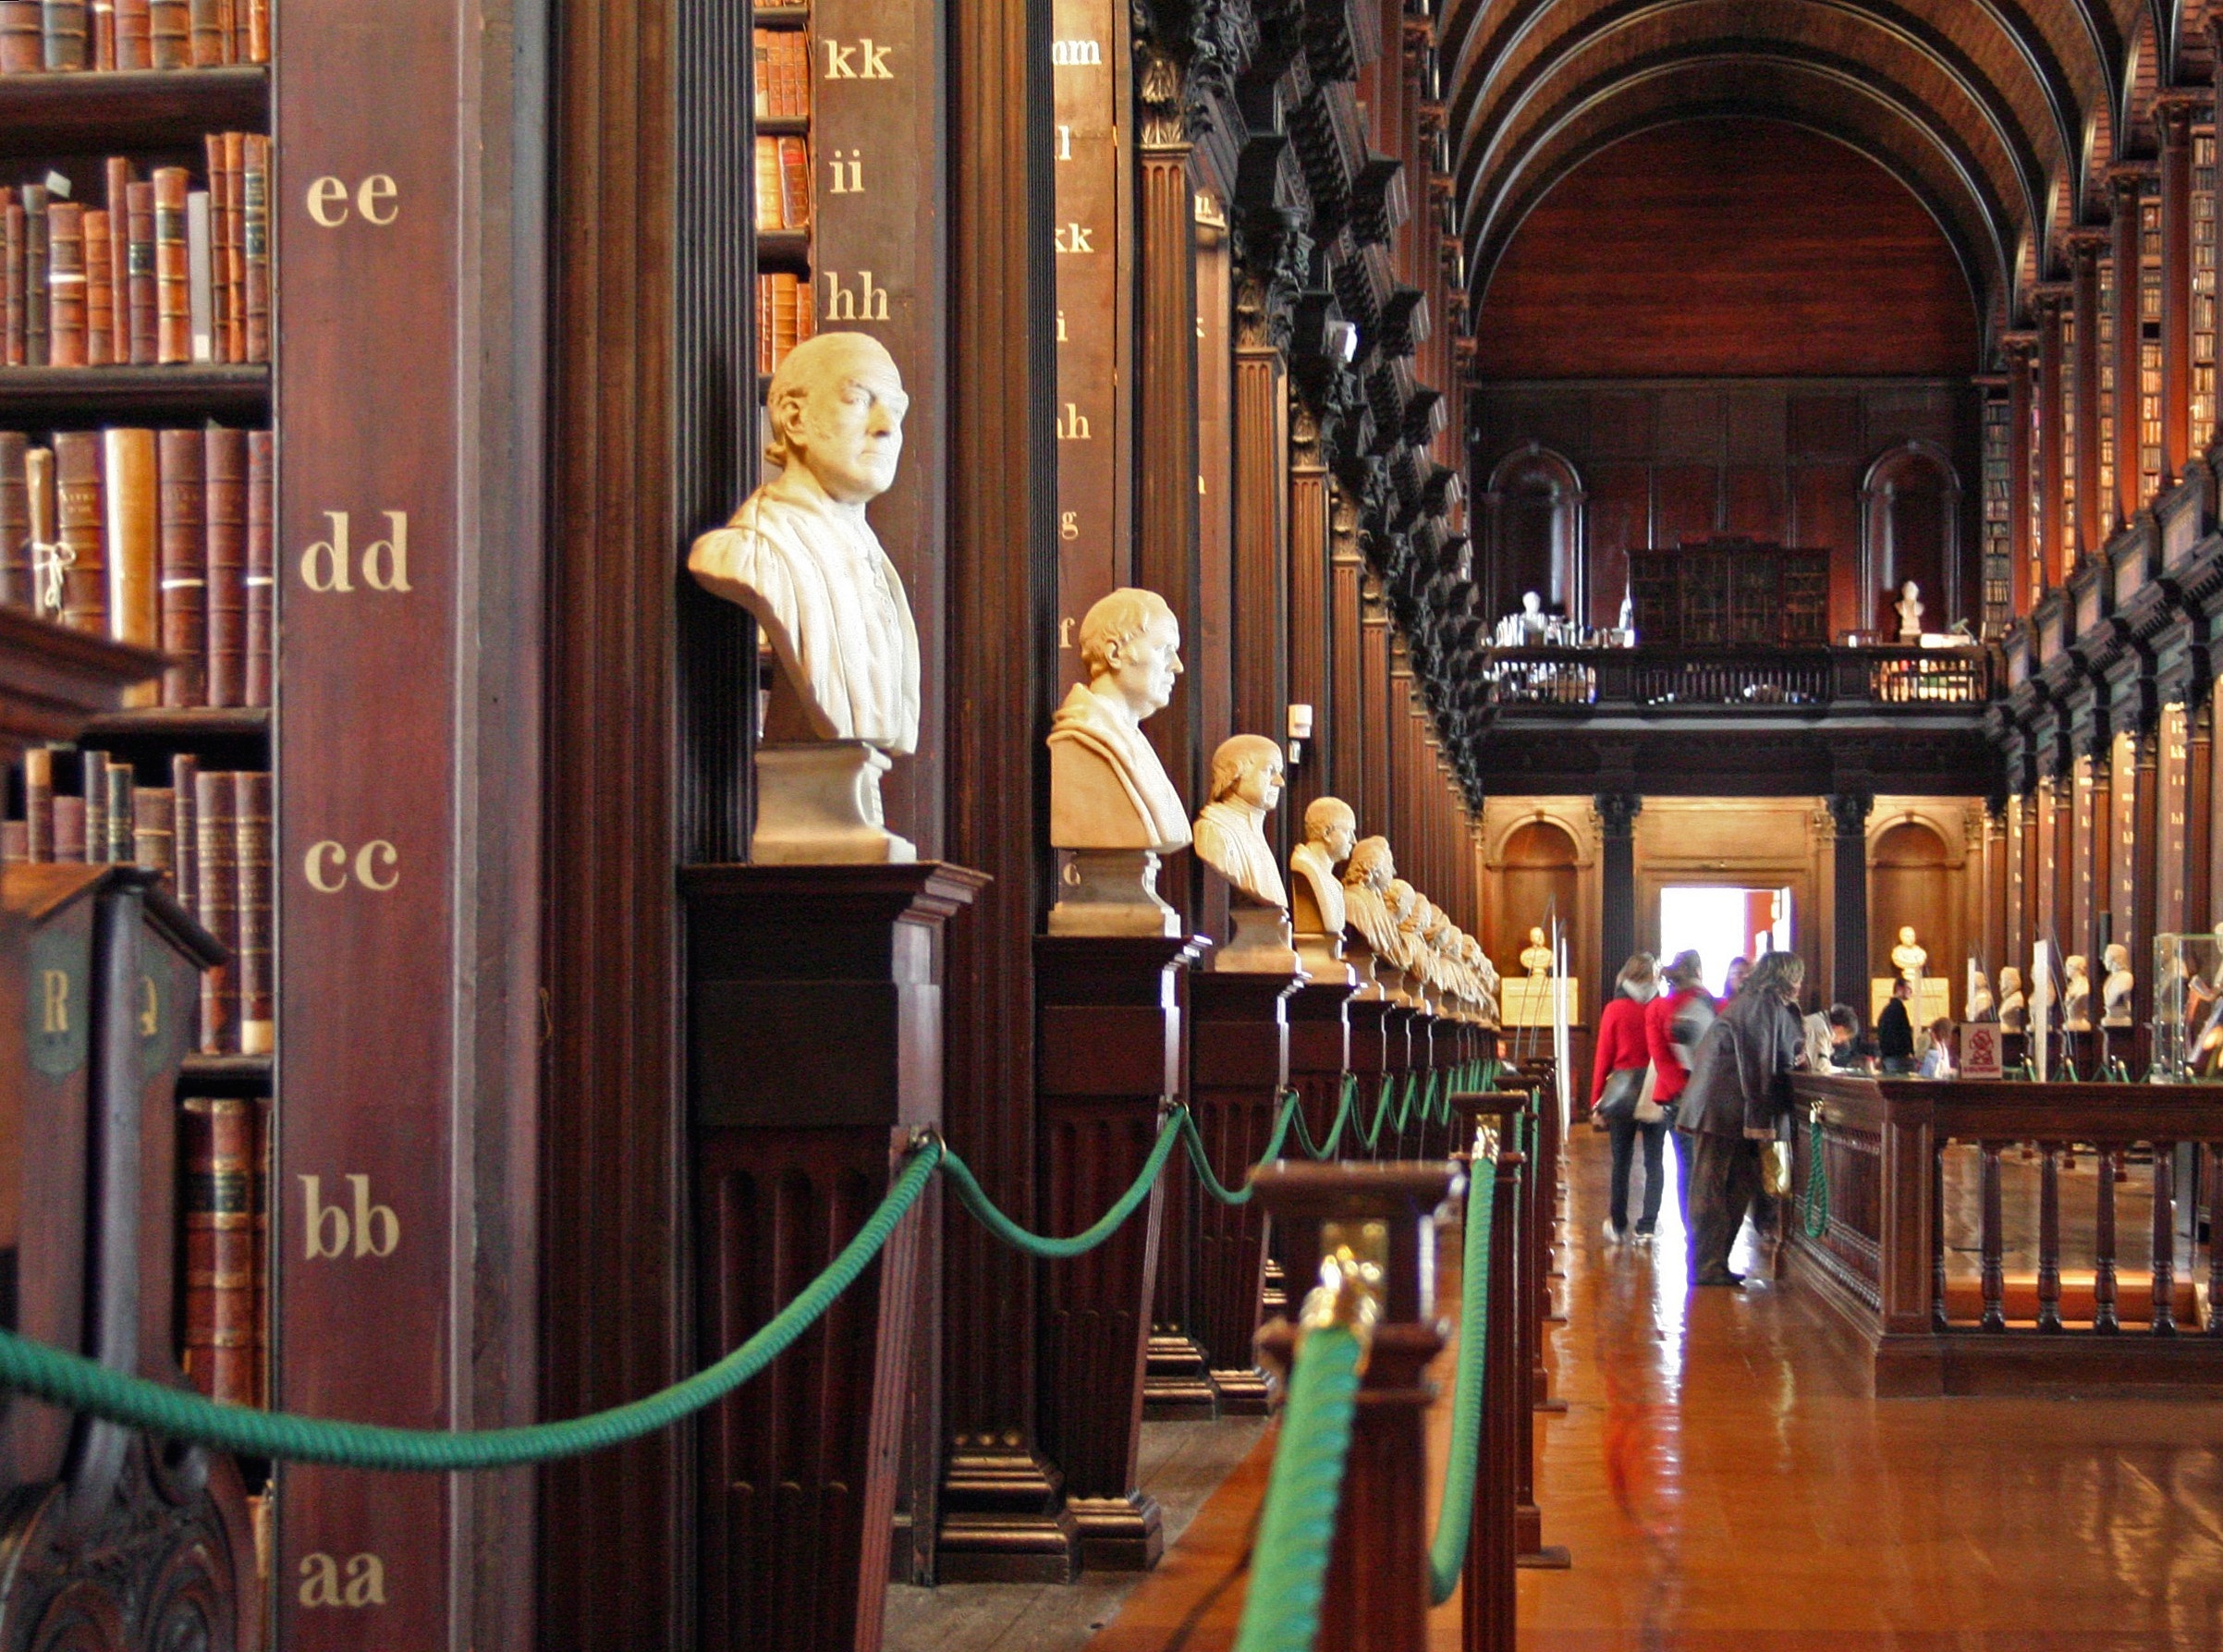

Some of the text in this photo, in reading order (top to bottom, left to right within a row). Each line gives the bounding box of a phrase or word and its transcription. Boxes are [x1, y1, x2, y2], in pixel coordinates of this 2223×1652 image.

[824, 39, 894, 80] kk
[829, 149, 864, 193] ii
[307, 176, 398, 226] ee
[824, 271, 890, 321] hh
[1057, 403, 1092, 439] h
[300, 510, 410, 593] dd
[304, 839, 399, 893] cc
[43, 970, 69, 1033] R
[298, 1174, 399, 1259] bb
[299, 1552, 385, 1608] aa
